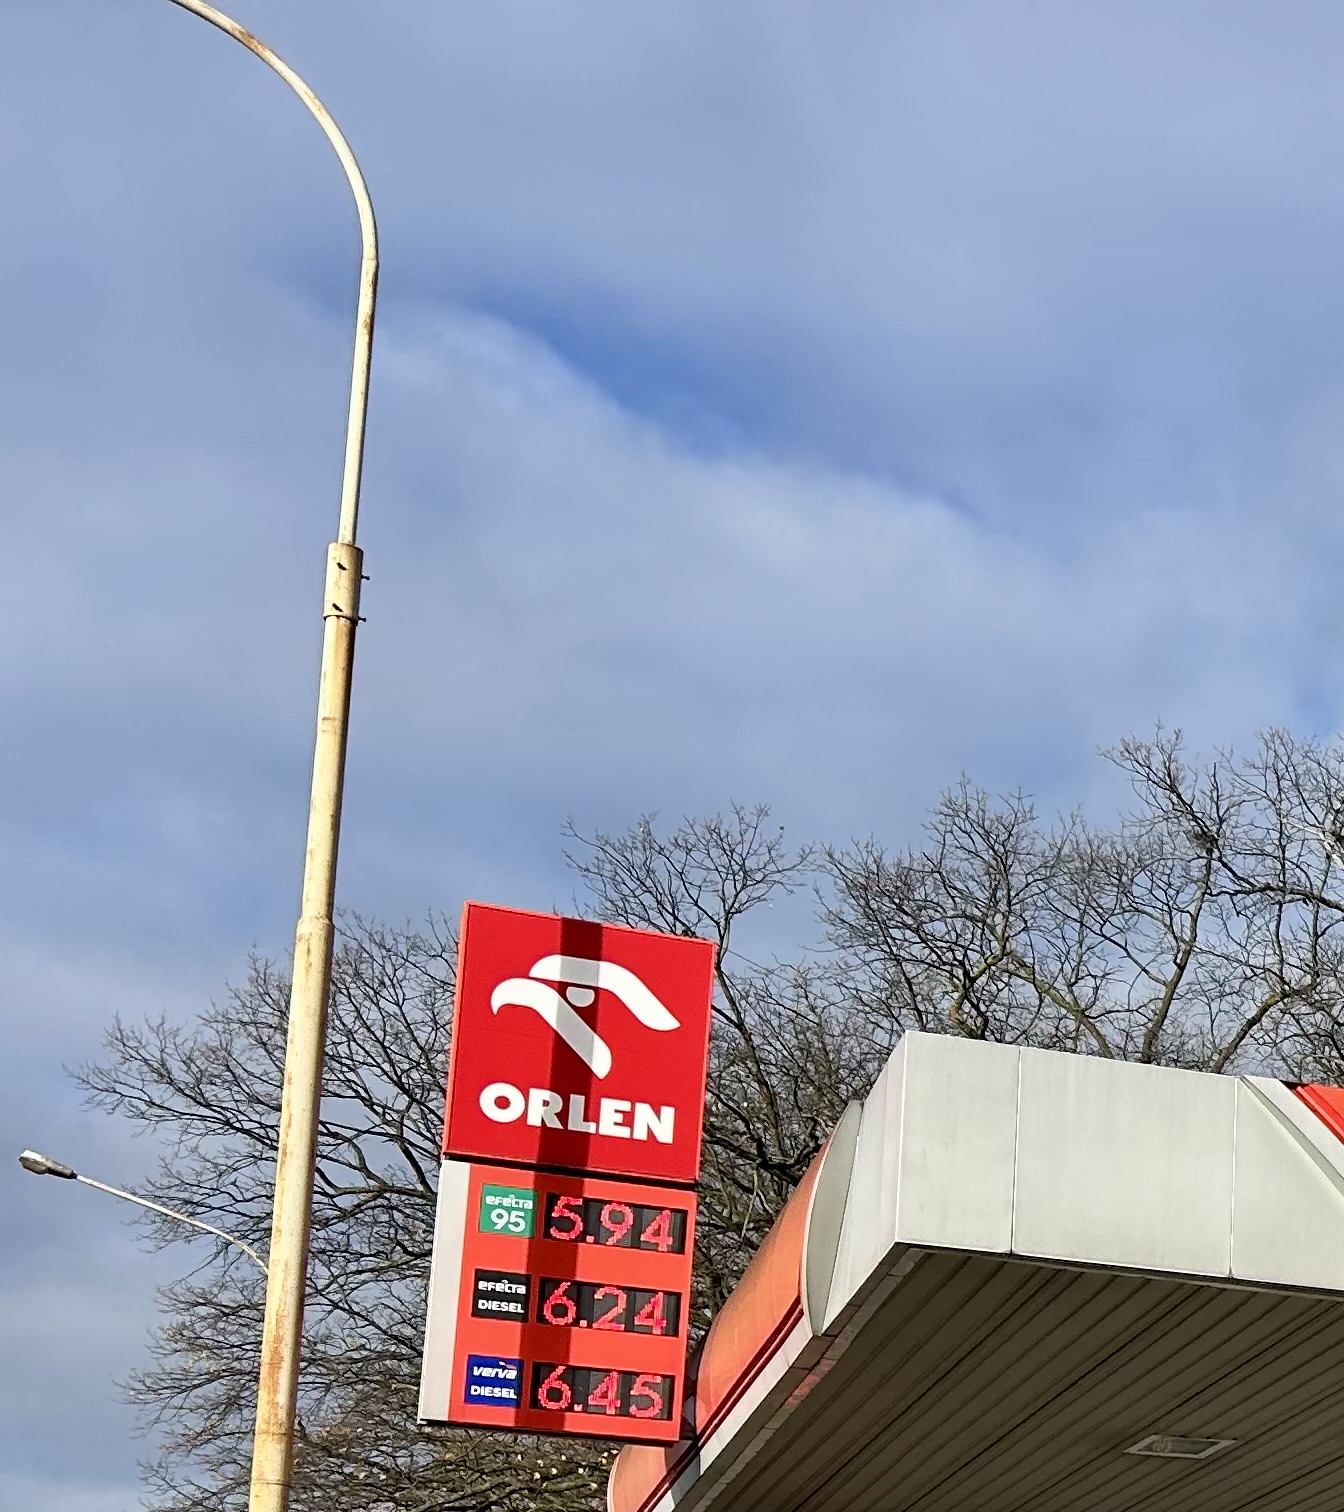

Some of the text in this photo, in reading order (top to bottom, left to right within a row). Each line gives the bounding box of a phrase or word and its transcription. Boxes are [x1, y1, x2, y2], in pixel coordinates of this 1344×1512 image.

[479, 1082, 675, 1144] ORLEN
[490, 1210, 526, 1233] 95
[550, 1196, 672, 1253] 5.94
[478, 1298, 525, 1315] DIESEL
[543, 1281, 667, 1336] 6.24
[472, 1362, 518, 1380] verva
[470, 1384, 517, 1400] DIESEL
[538, 1366, 663, 1419] 6.45
